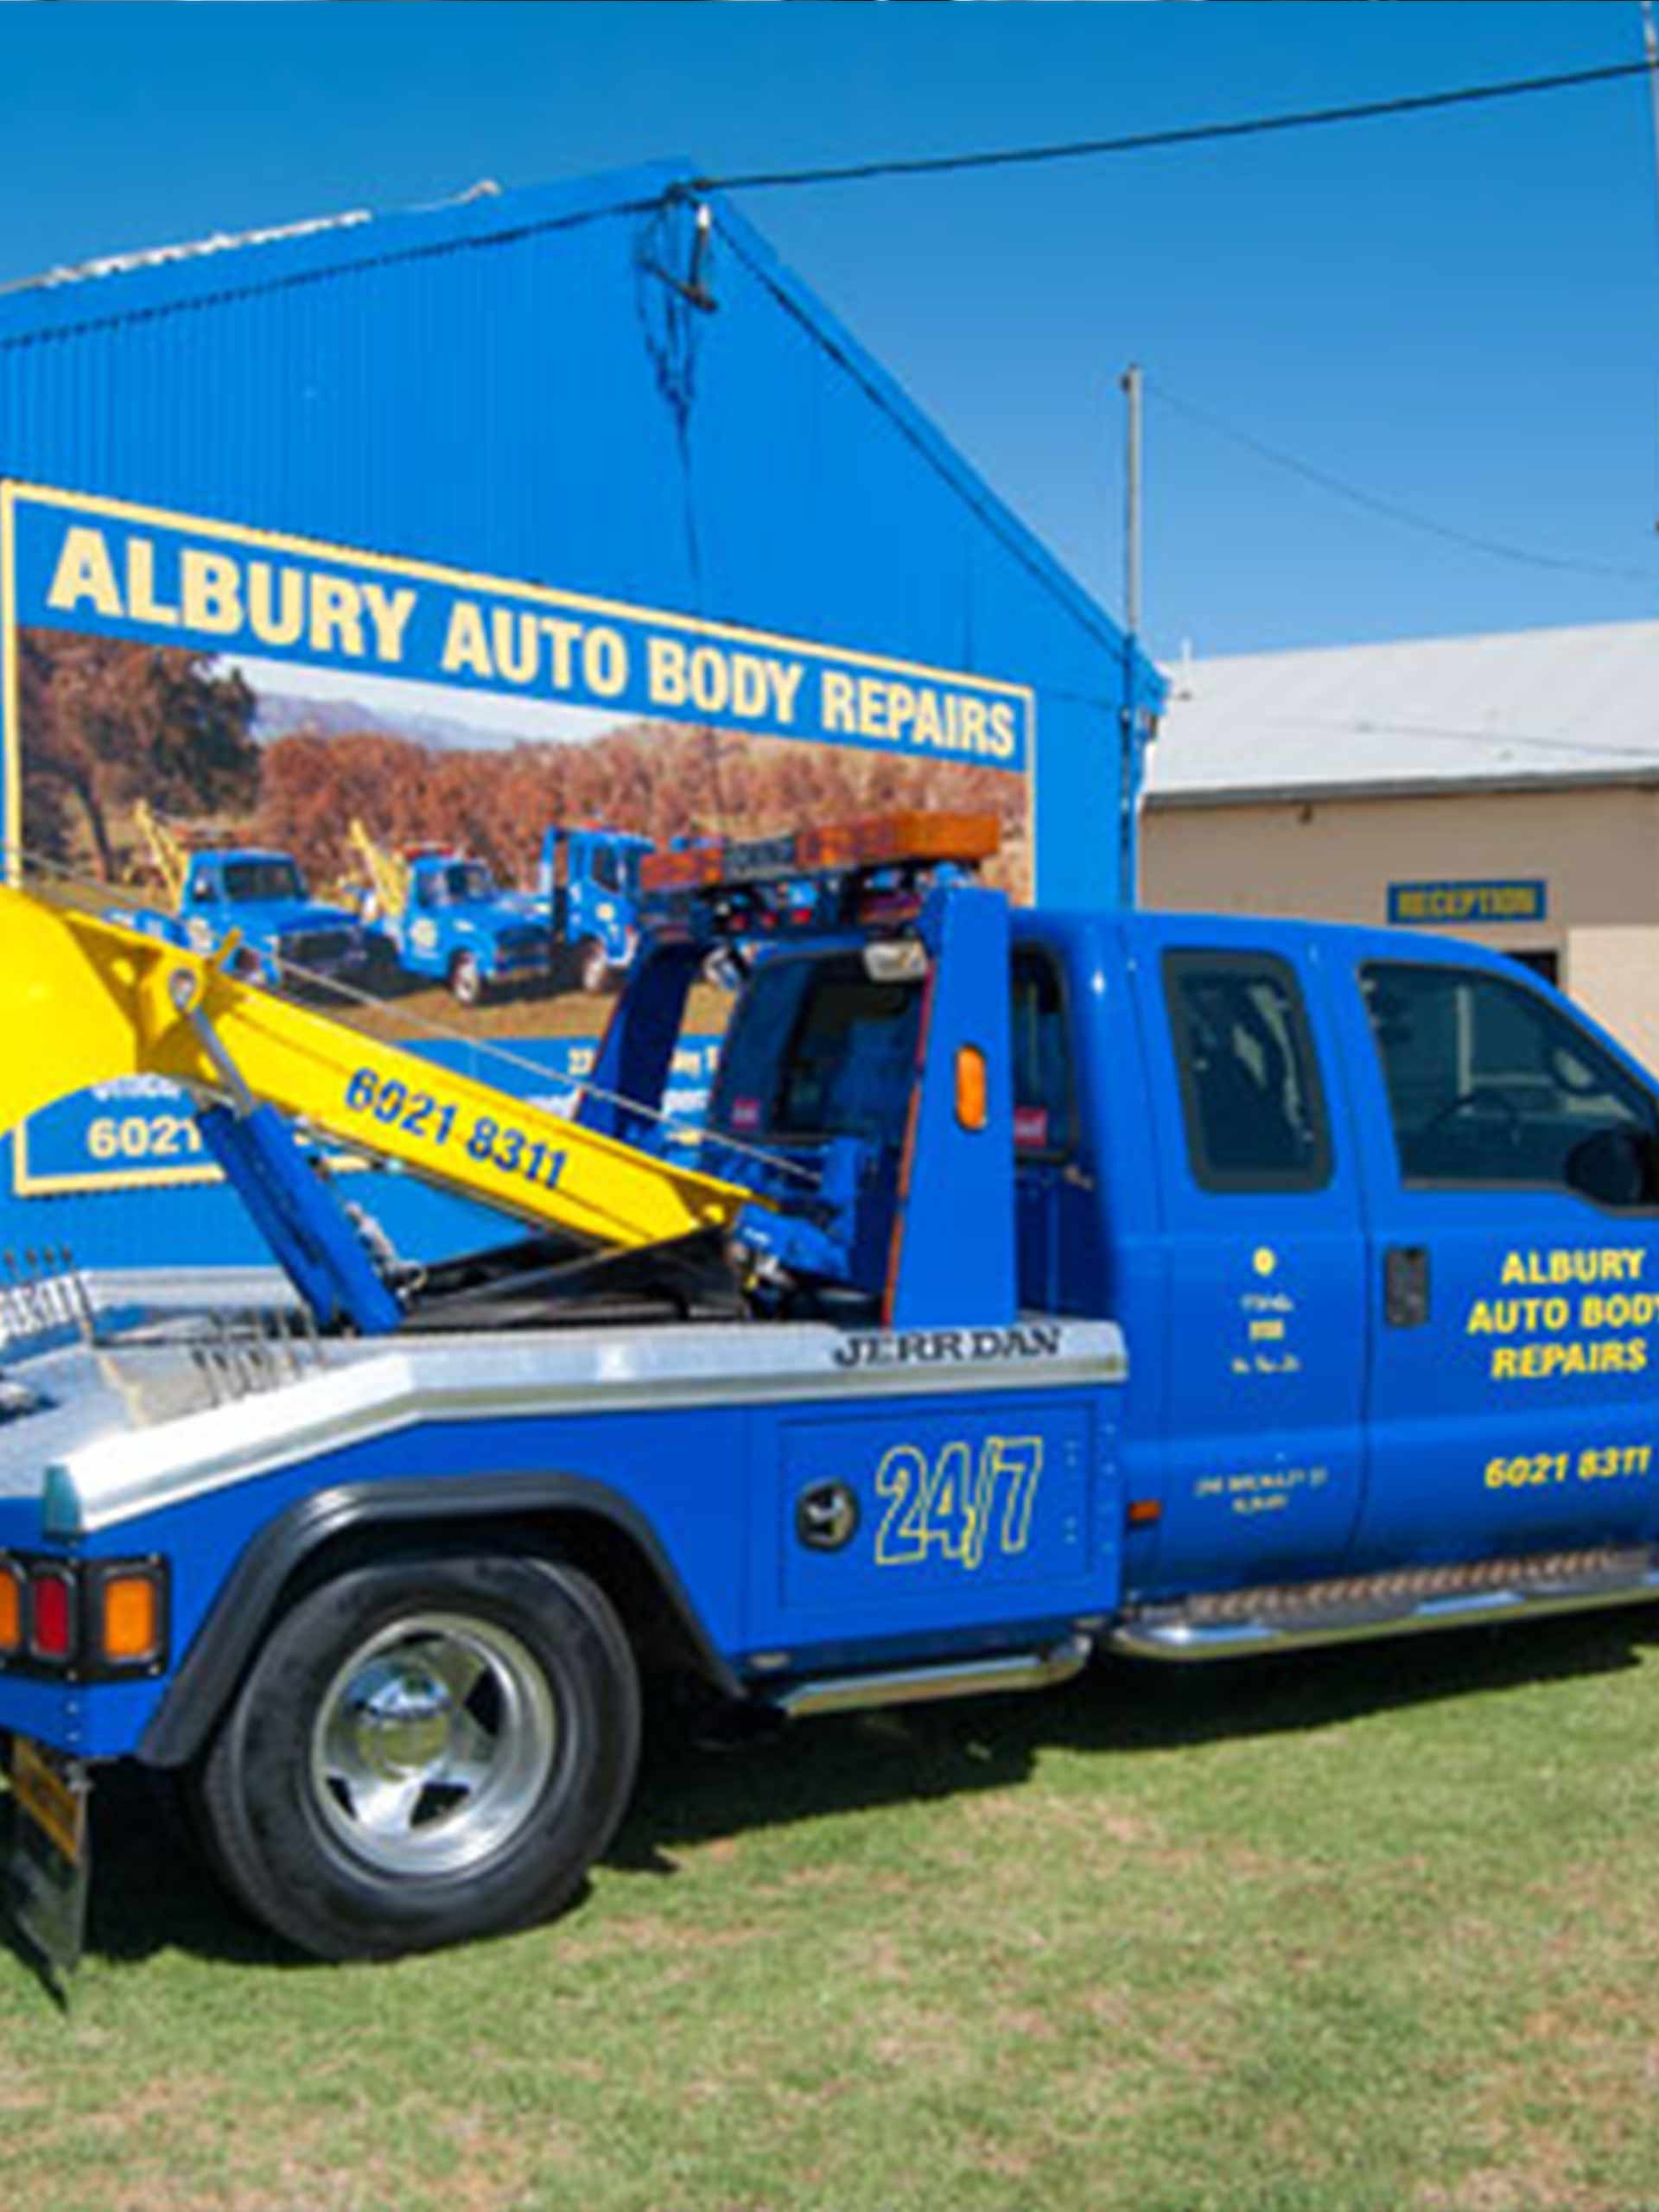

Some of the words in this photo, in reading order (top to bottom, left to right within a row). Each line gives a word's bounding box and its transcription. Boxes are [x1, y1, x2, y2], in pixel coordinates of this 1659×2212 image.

[46, 526, 416, 662] ALBURY
[441, 601, 628, 696] AUTO
[647, 638, 804, 723] BODY
[821, 671, 1014, 758] REPAIRS
[88, 1116, 200, 1159] 6021
[344, 1067, 458, 1147] 6021
[465, 1117, 568, 1191] 8311
[1501, 1248, 1645, 1284] ALBURY
[1466, 1297, 1569, 1333] AUTO
[1581, 1292, 1659, 1328] BOD
[1491, 1338, 1648, 1379] REPAIRS
[1484, 1452, 1568, 1488] 6021
[1579, 1446, 1650, 1479] 8311
[875, 1435, 1043, 1569] 24/7
